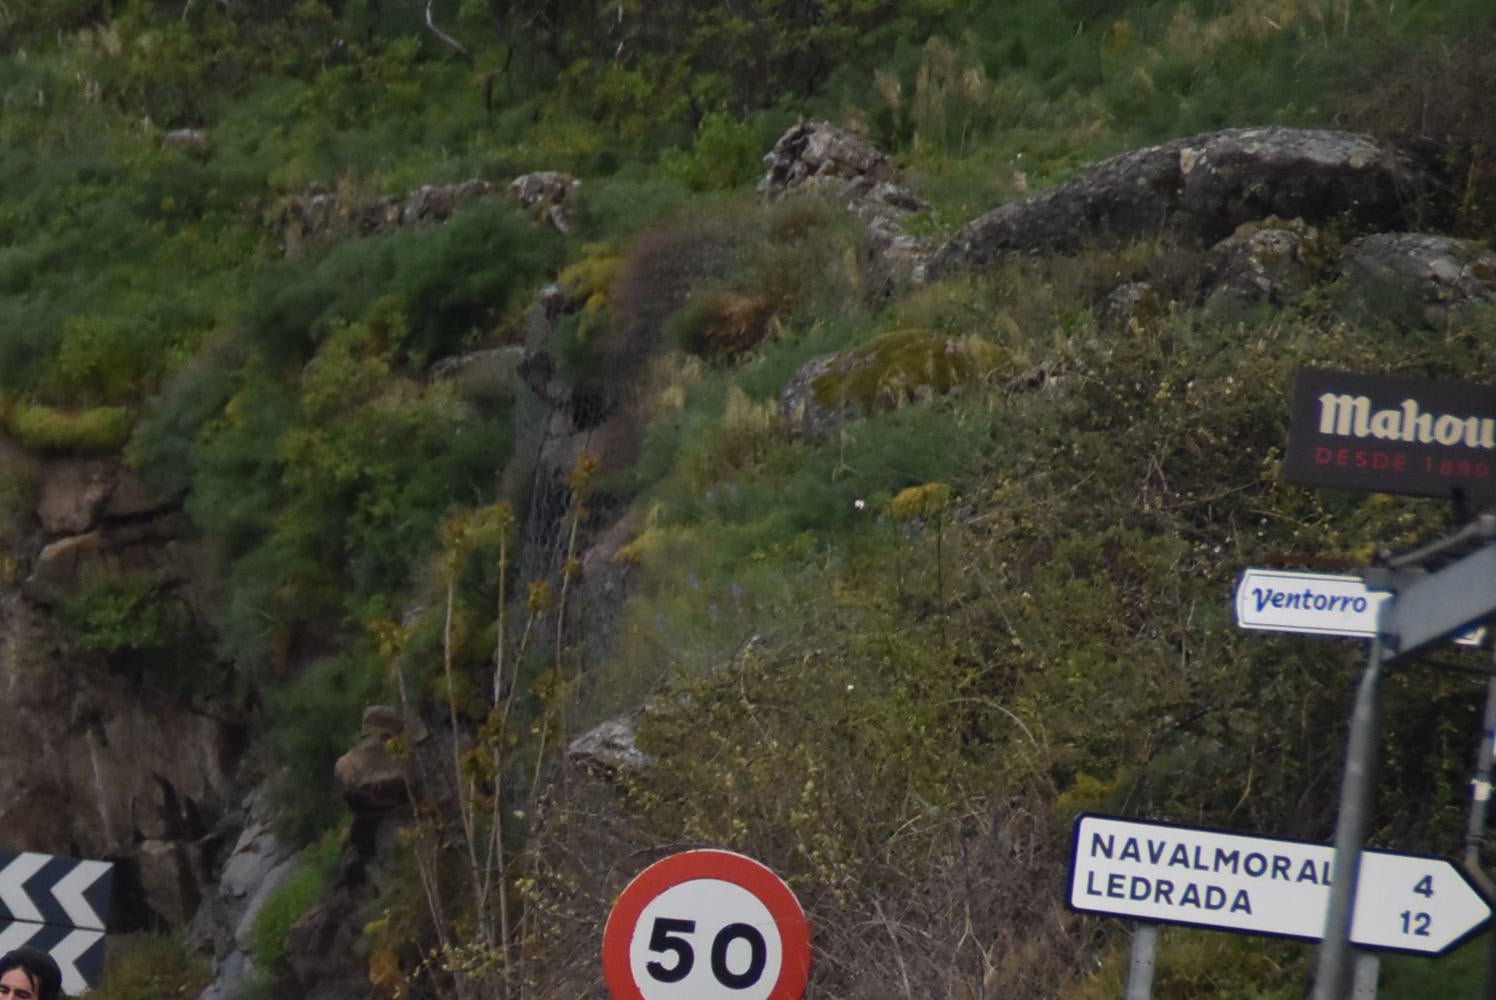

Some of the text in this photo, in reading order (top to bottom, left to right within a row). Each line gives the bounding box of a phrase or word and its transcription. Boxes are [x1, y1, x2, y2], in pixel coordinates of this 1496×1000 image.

[1319, 392, 1495, 449] Mahou
[1315, 447, 1489, 477] DESDE 1890
[1252, 587, 1367, 613] Ventorro
[1090, 832, 1434, 898] NAVALMORAL 4
[1086, 871, 1432, 937] LEDRADA 12
[646, 917, 767, 990] 50
